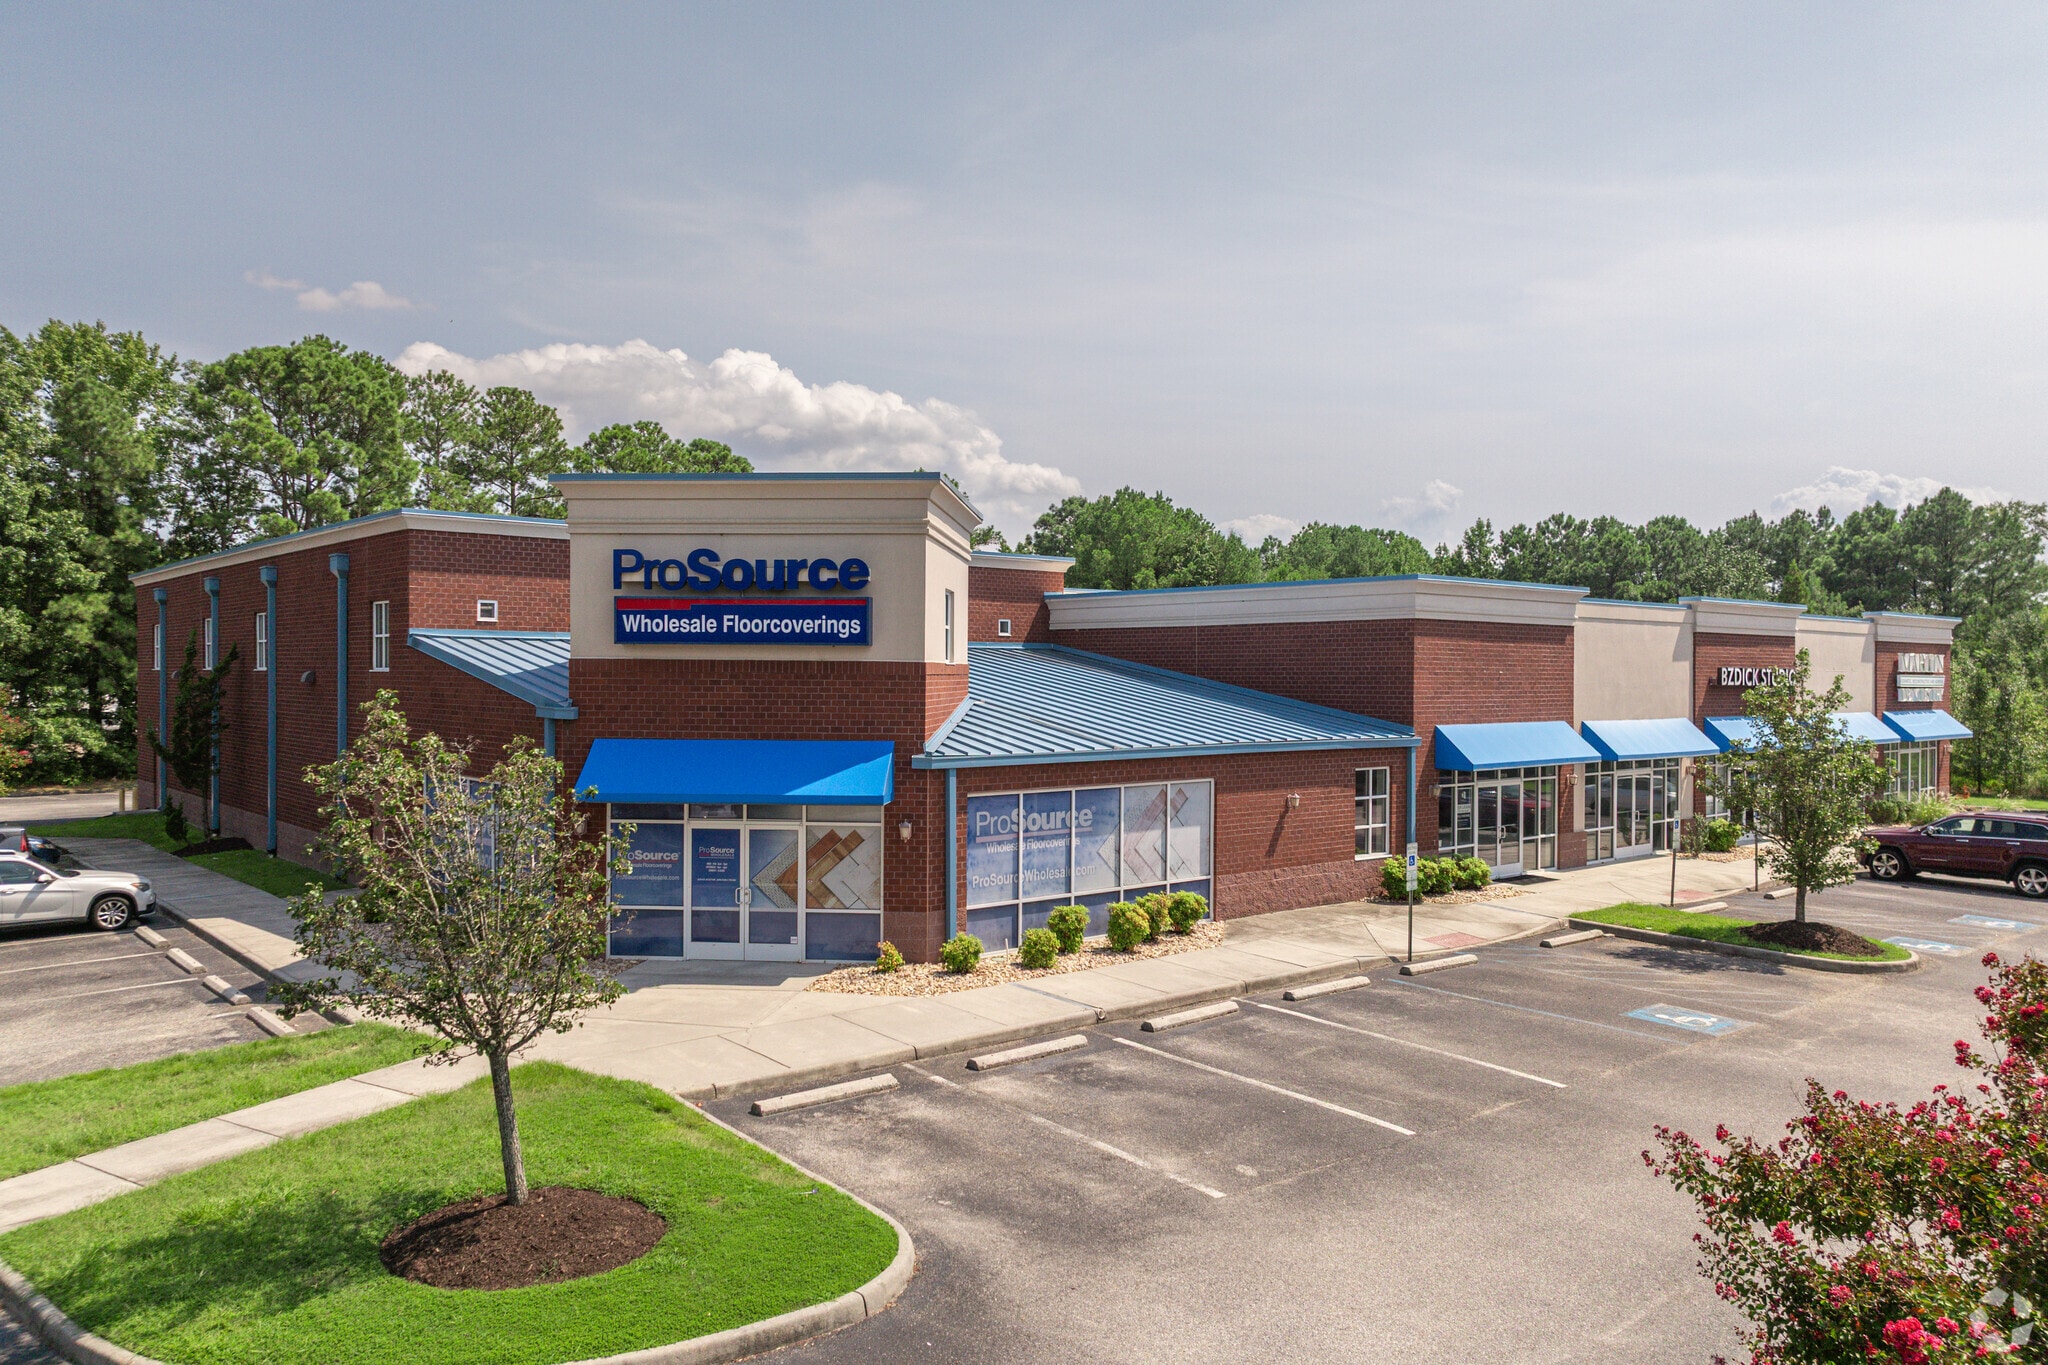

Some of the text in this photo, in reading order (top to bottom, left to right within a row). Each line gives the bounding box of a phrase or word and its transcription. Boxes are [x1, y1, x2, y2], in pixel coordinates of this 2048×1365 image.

[613, 548, 870, 591] ProSource
[622, 614, 861, 638] Wholesale Floorcoverings
[1721, 667, 1759, 686] BZDICK
[987, 835, 1081, 854] Wholese Floorcoverins
[617, 850, 679, 861] oSource
